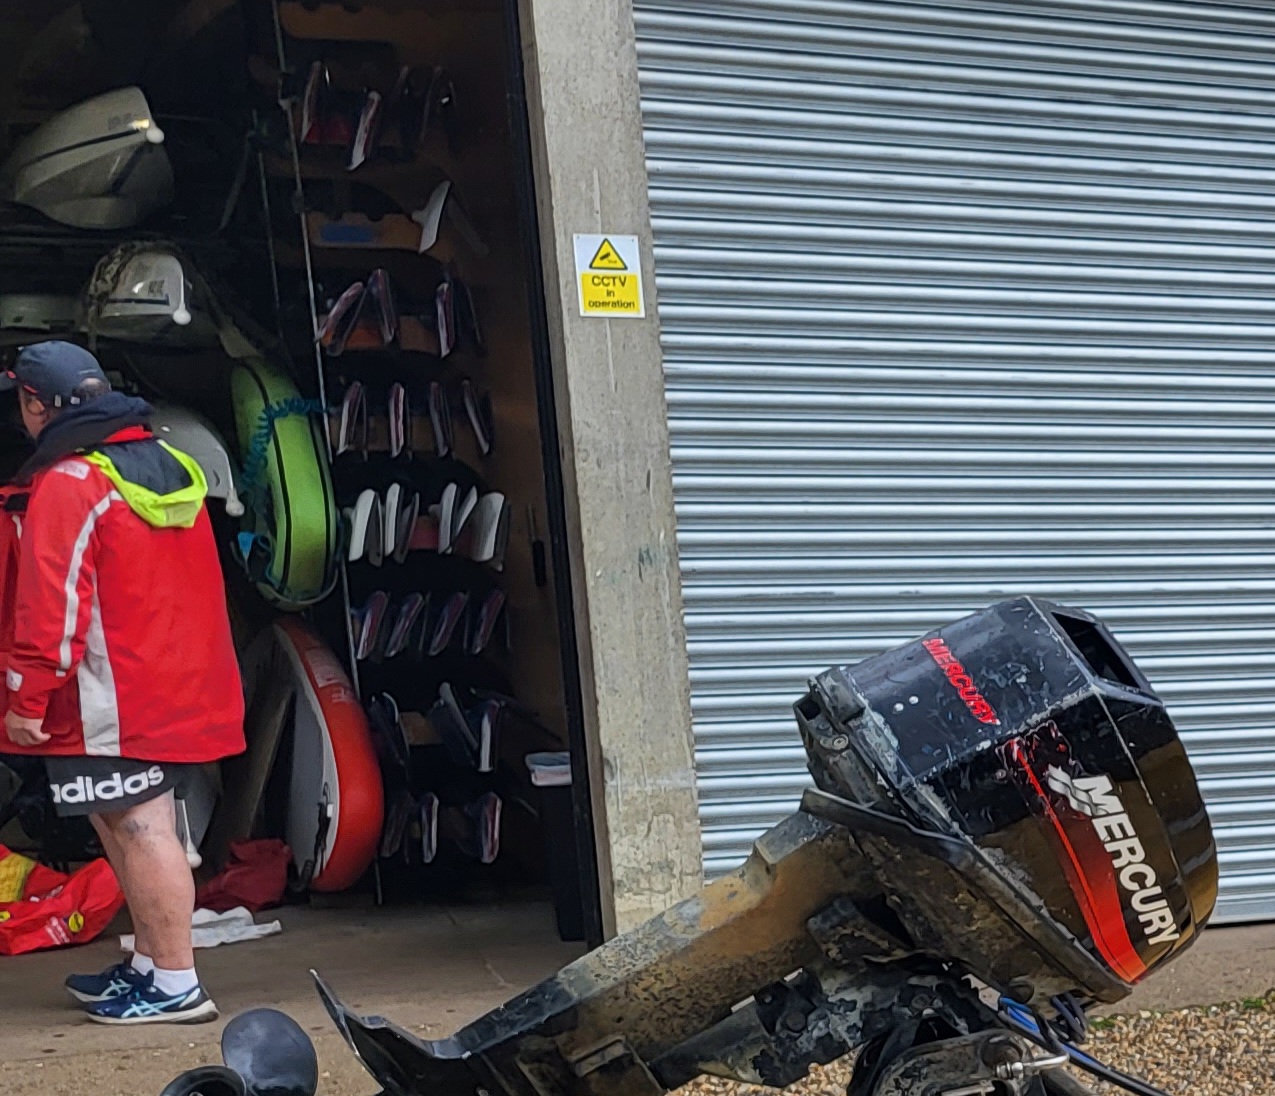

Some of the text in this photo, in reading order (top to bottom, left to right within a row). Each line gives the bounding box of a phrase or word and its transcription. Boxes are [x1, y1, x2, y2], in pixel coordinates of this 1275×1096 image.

[591, 275, 627, 288] CCTV
[606, 289, 615, 297] in
[588, 299, 635, 309] operation
[922, 638, 1001, 725] MERCURY
[1072, 774, 1180, 945] MERCURY
